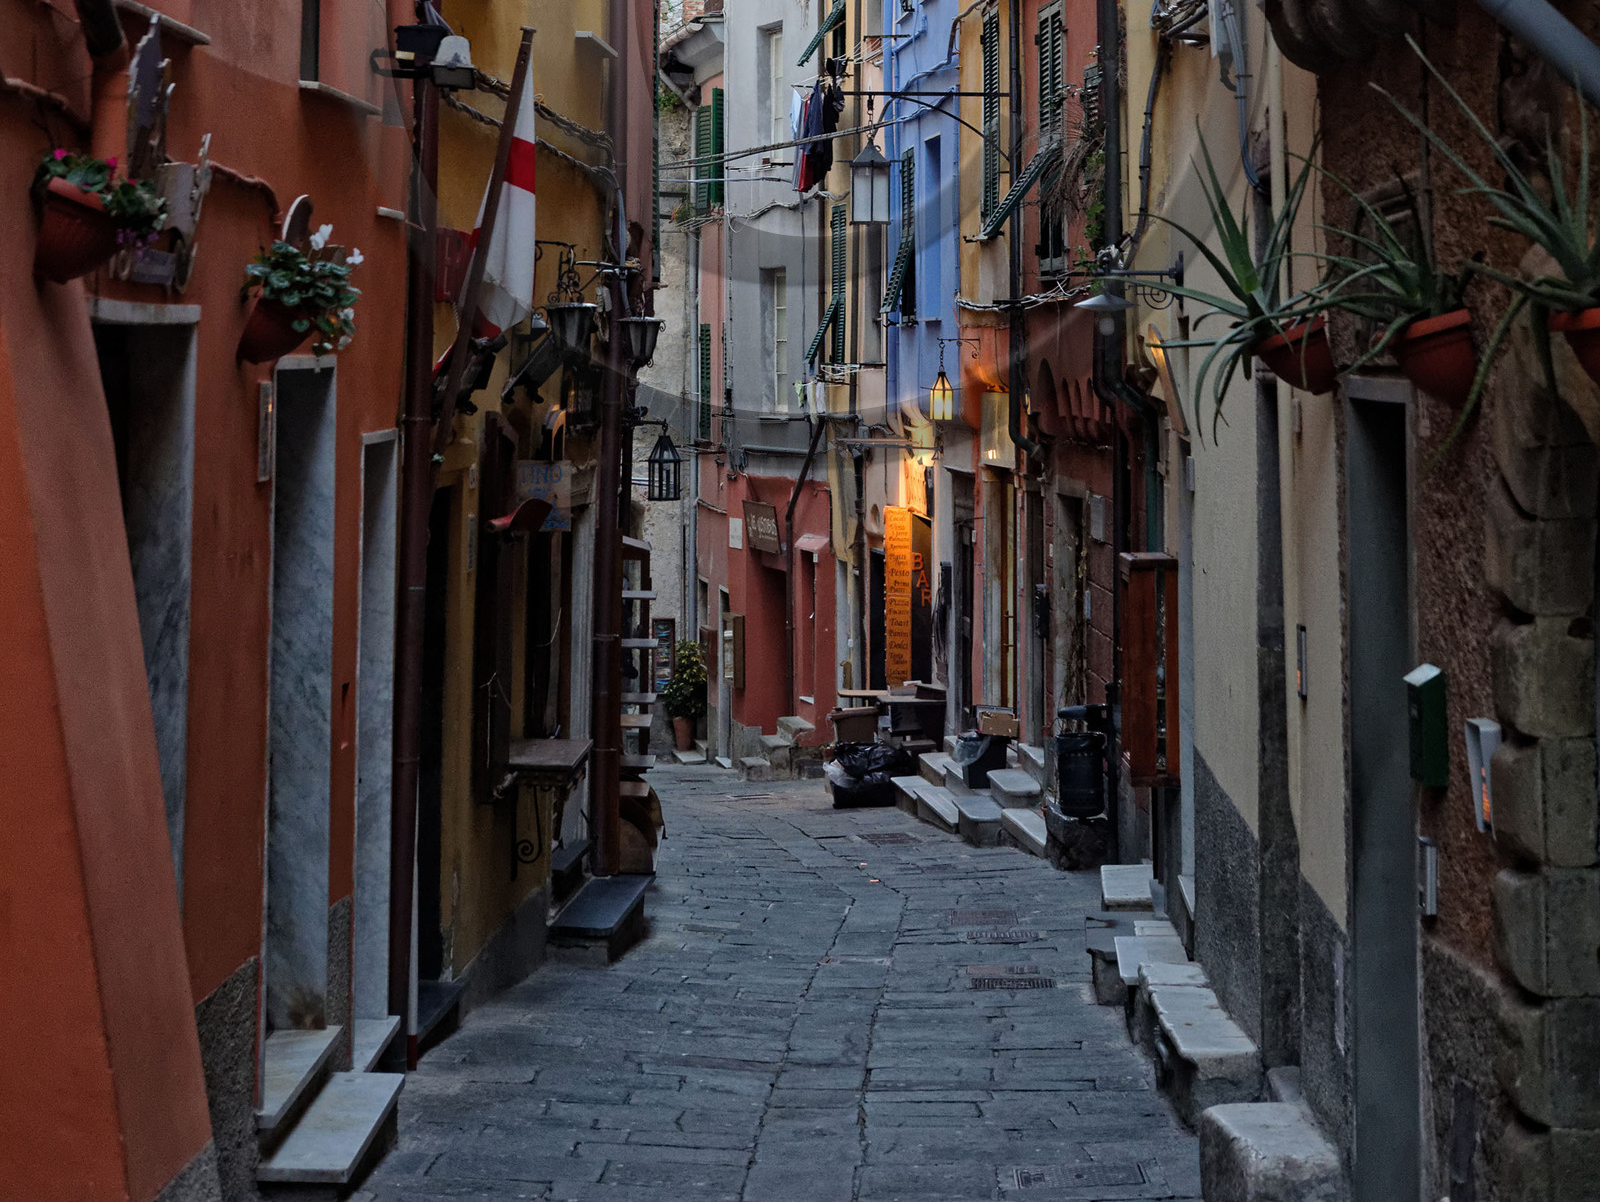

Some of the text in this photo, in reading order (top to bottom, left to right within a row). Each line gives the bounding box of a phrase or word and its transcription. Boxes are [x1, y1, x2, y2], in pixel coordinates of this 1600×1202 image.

[891, 568, 910, 577] Pesto
[911, 552, 932, 607] BAR
[890, 618, 909, 627] Toast
